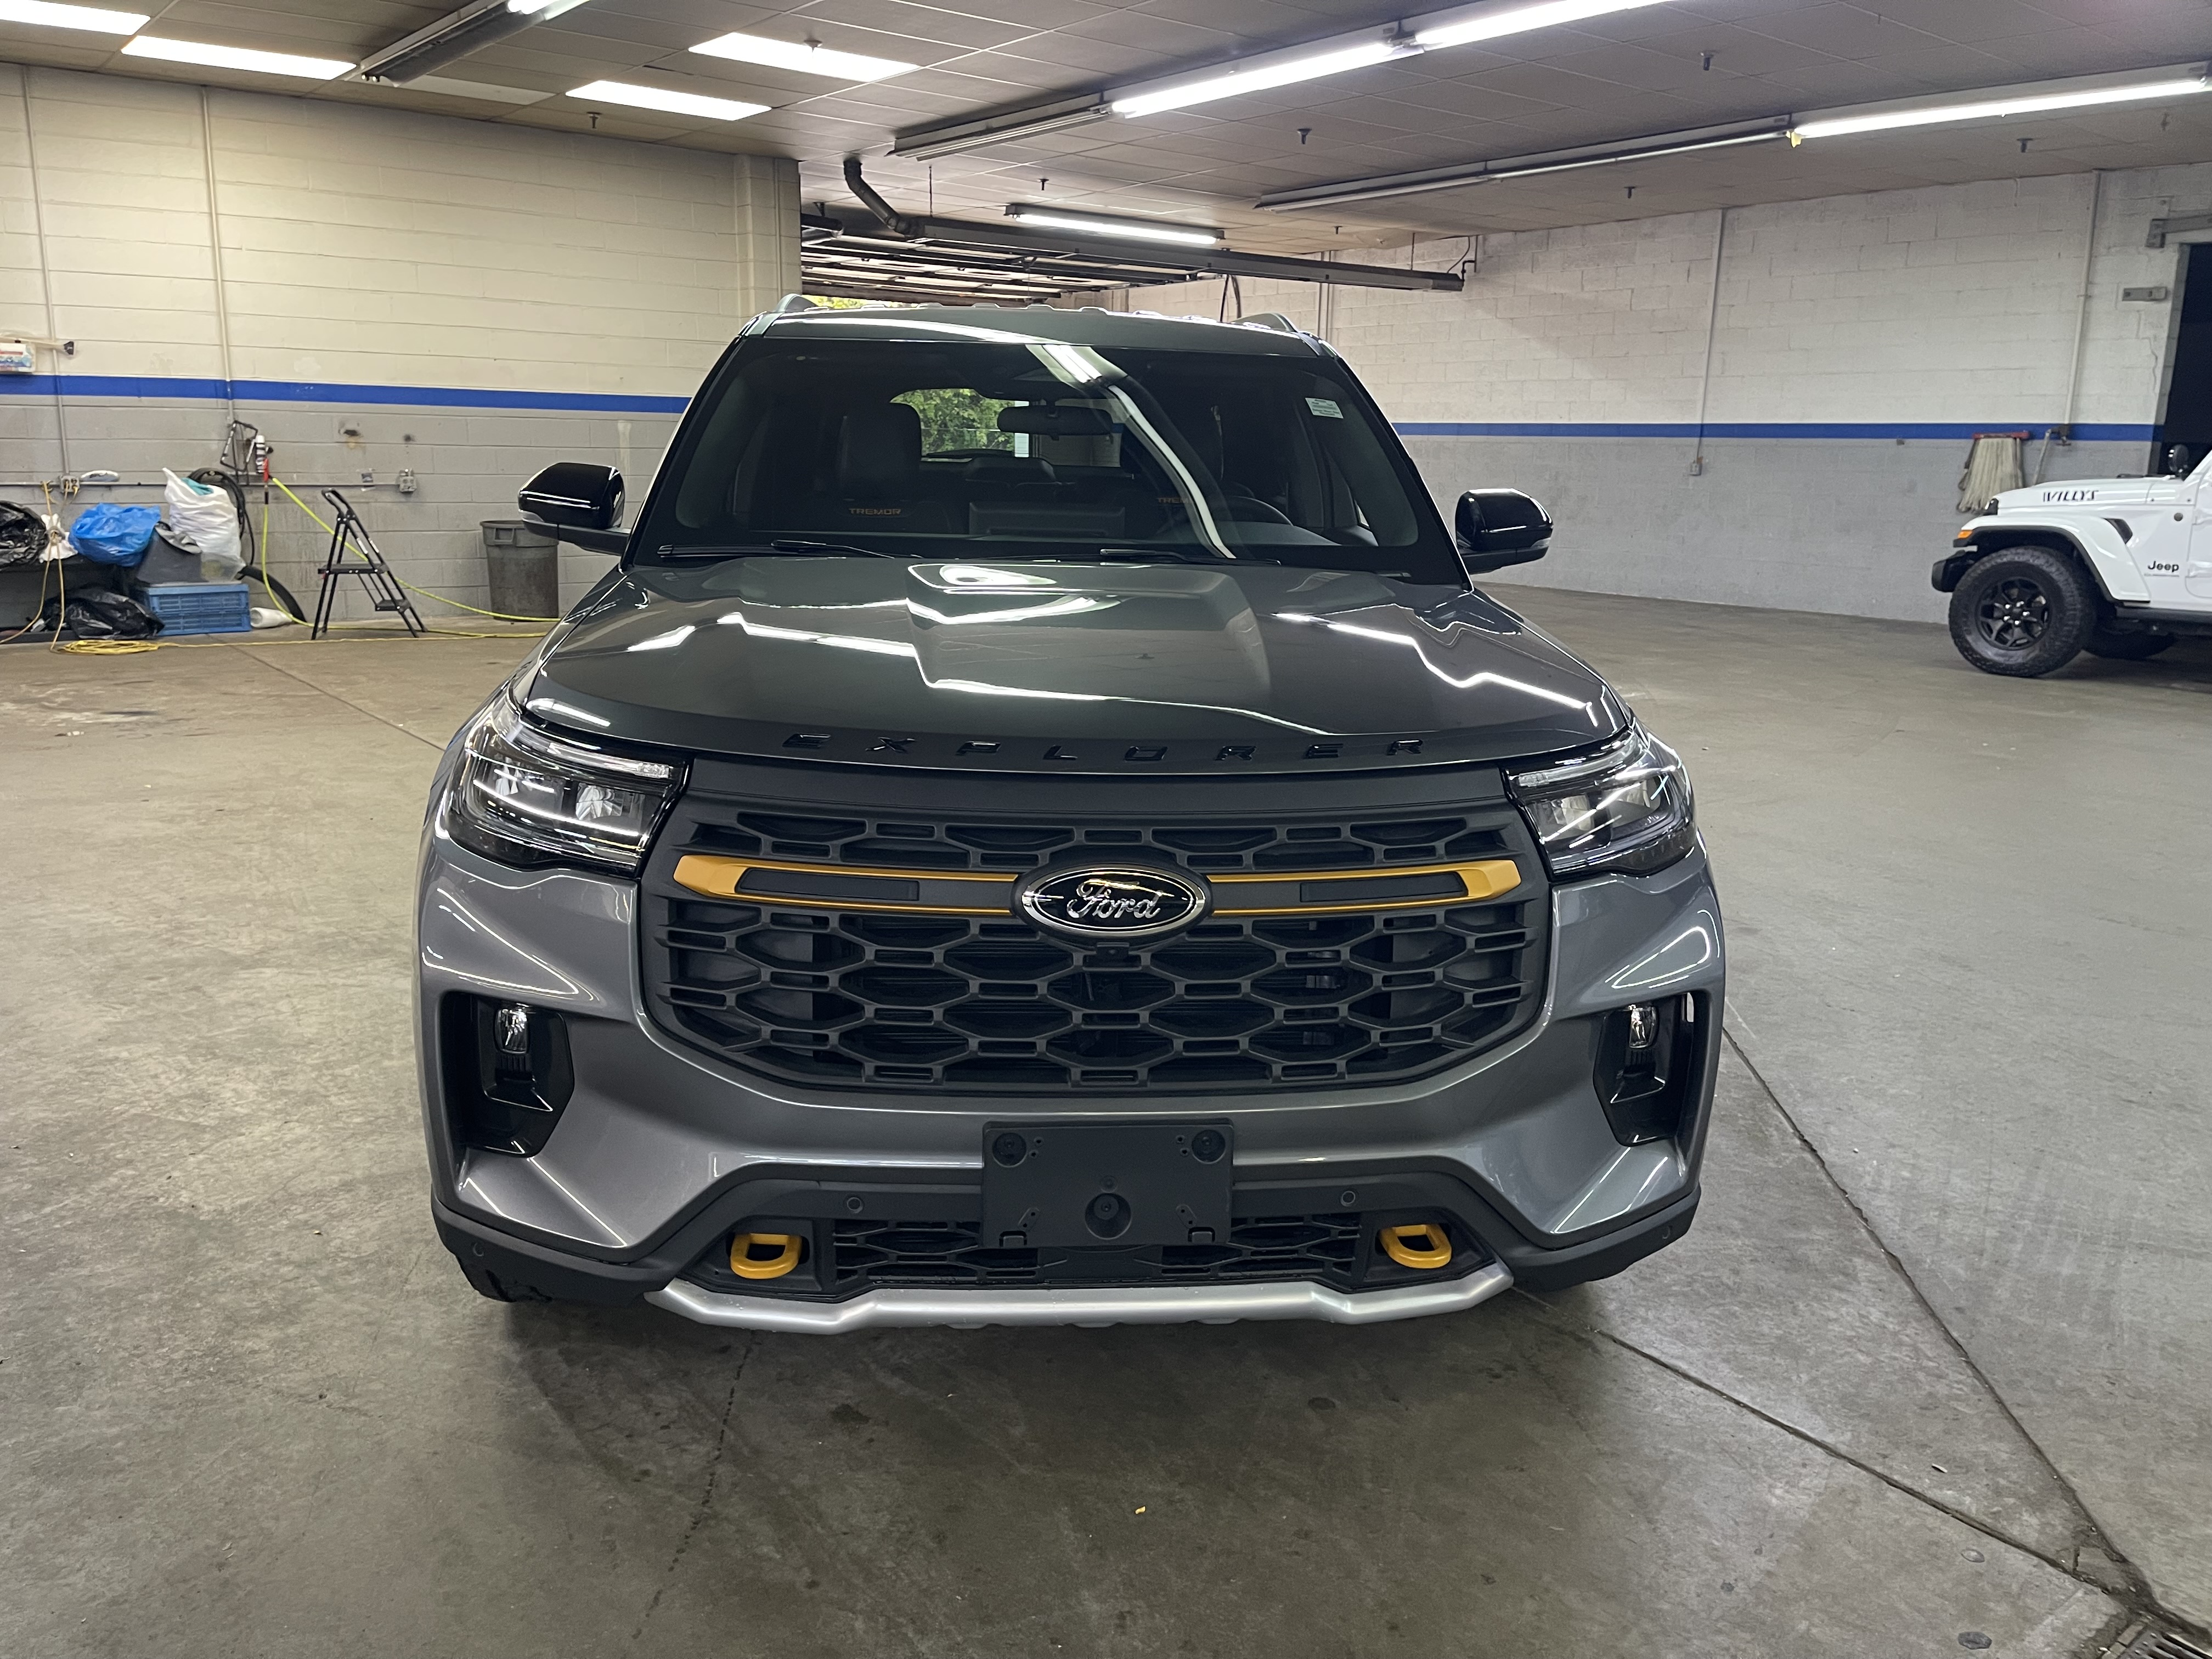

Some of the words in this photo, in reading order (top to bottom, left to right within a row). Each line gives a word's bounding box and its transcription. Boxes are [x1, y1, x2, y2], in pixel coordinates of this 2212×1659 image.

[2043, 489, 2099, 502] WILLYS
[2147, 561, 2179, 573] Jeep
[782, 733, 1424, 761] EXPLORER
[1066, 878, 1175, 919] Ford
